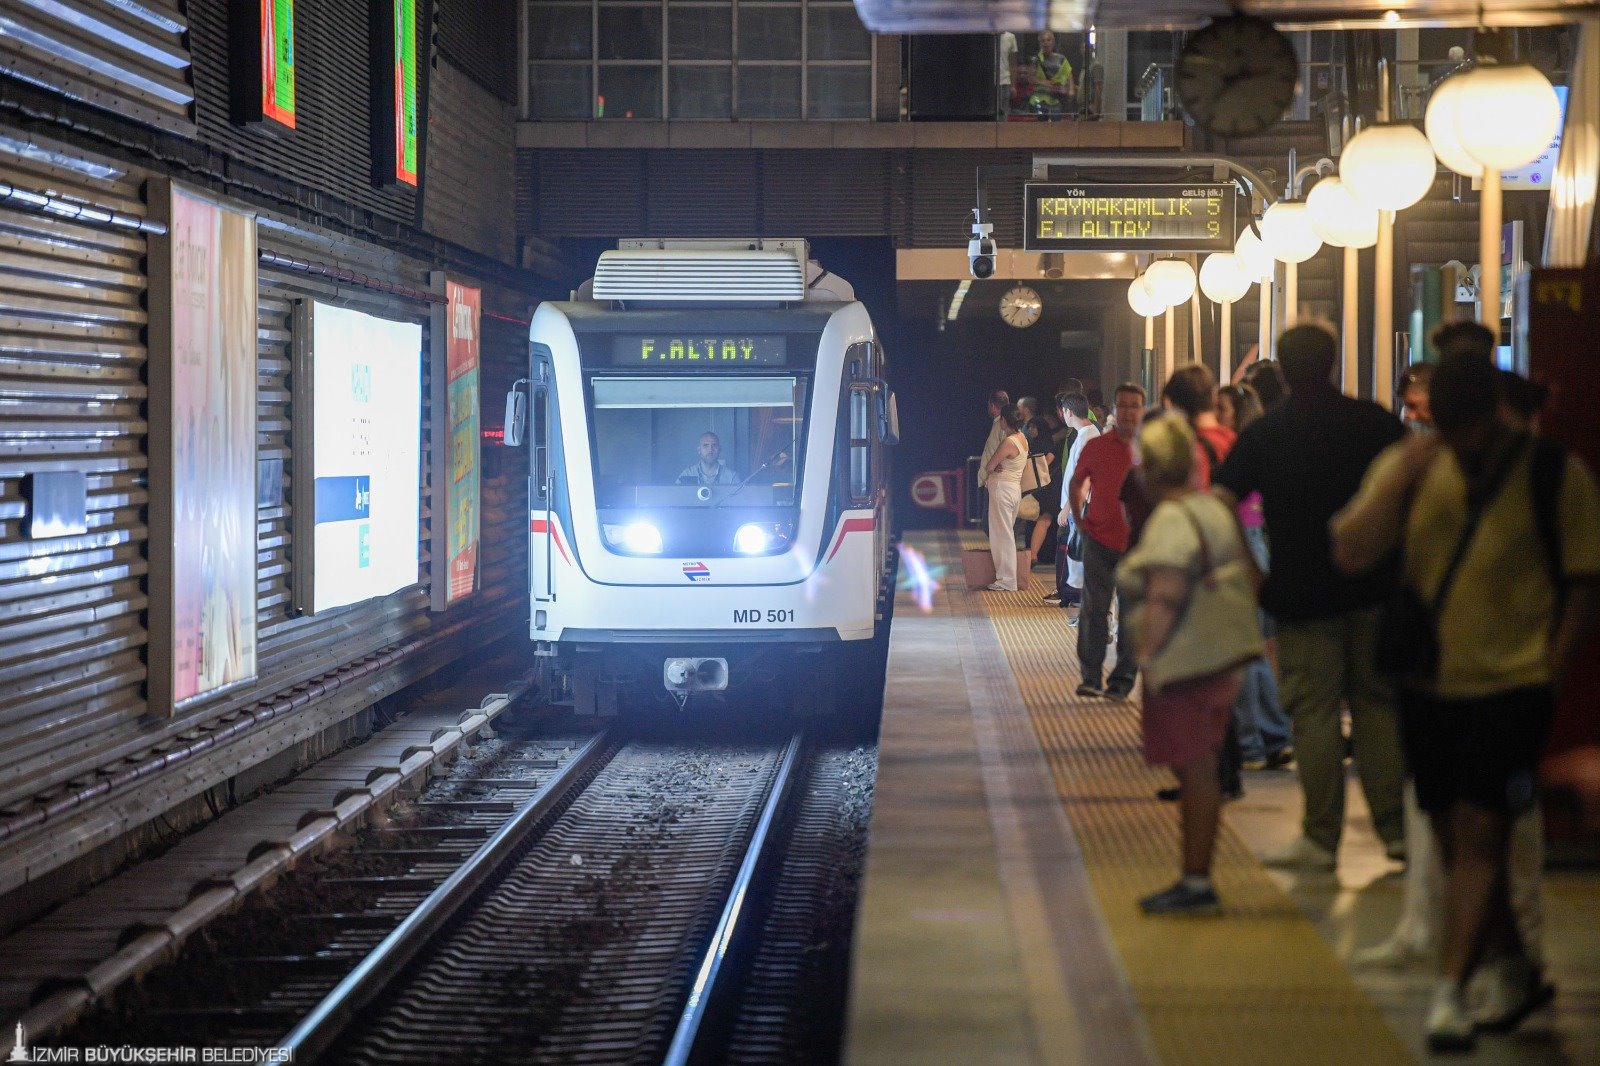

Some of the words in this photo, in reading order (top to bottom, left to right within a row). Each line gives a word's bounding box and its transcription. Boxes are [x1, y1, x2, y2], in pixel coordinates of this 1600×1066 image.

[1067, 189, 1086, 197] YÖN
[1182, 189, 1206, 198] GELİŞ
[1207, 189, 1224, 198] (dk.)
[1041, 198, 1192, 215] KAYMAKAMLIK
[1207, 198, 1220, 215] 5
[1041, 221, 1063, 238] F.
[1082, 221, 1150, 238] ALTAY
[1207, 221, 1220, 238] 9
[642, 339, 754, 360] F.ALTAY
[733, 609, 762, 623] MD
[766, 609, 795, 623] 501
